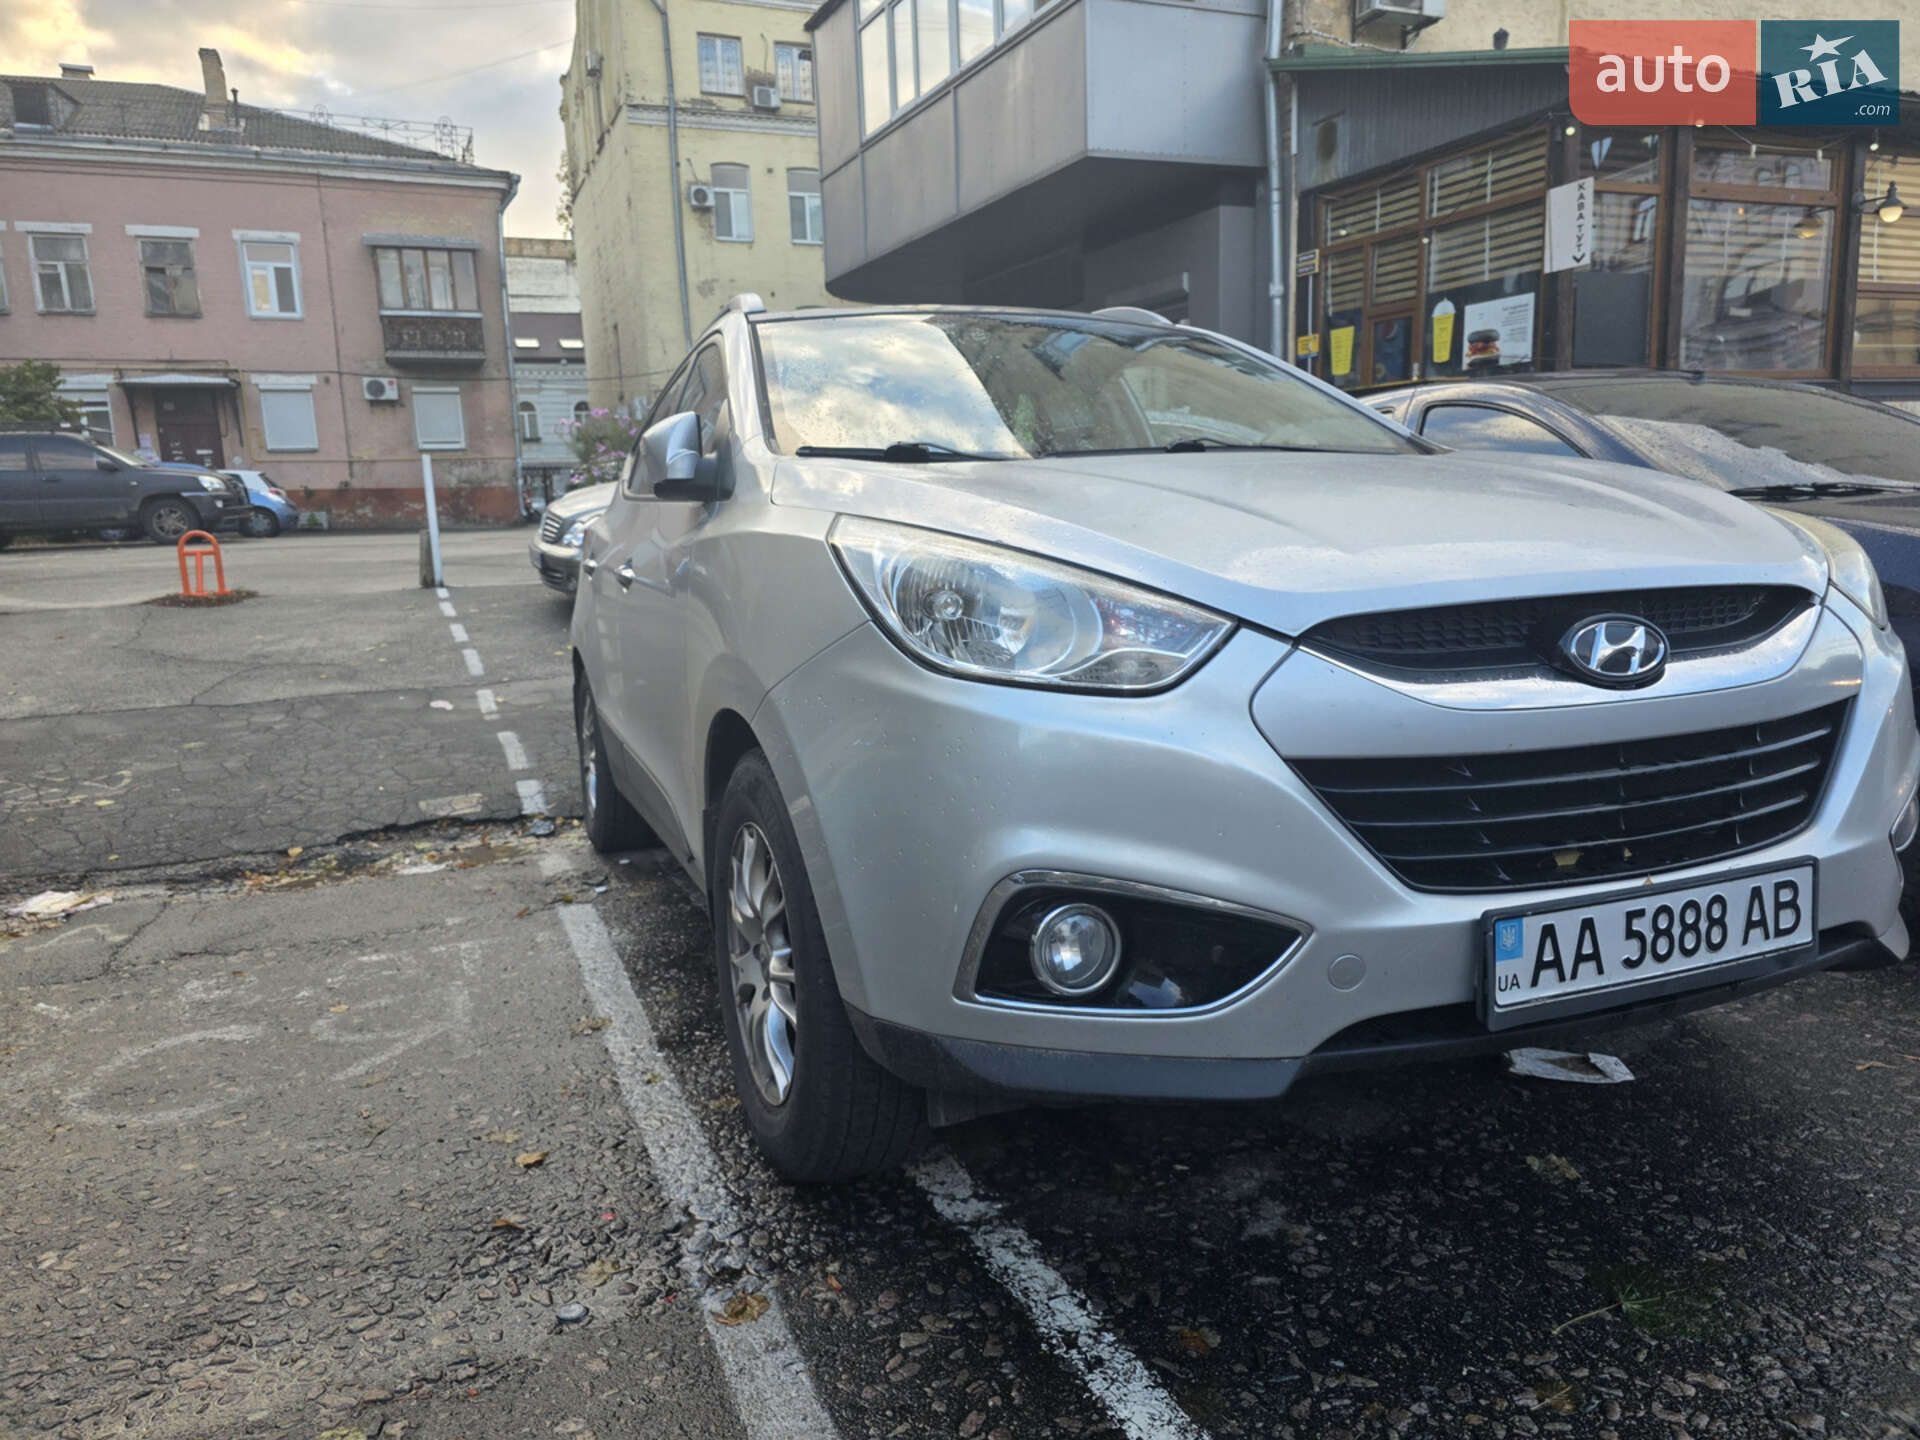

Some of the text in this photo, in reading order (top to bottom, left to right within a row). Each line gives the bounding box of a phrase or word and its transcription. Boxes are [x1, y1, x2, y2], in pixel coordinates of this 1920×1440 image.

[1530, 879, 1802, 988] AA 5888 AB
[1497, 974, 1521, 993] UA
